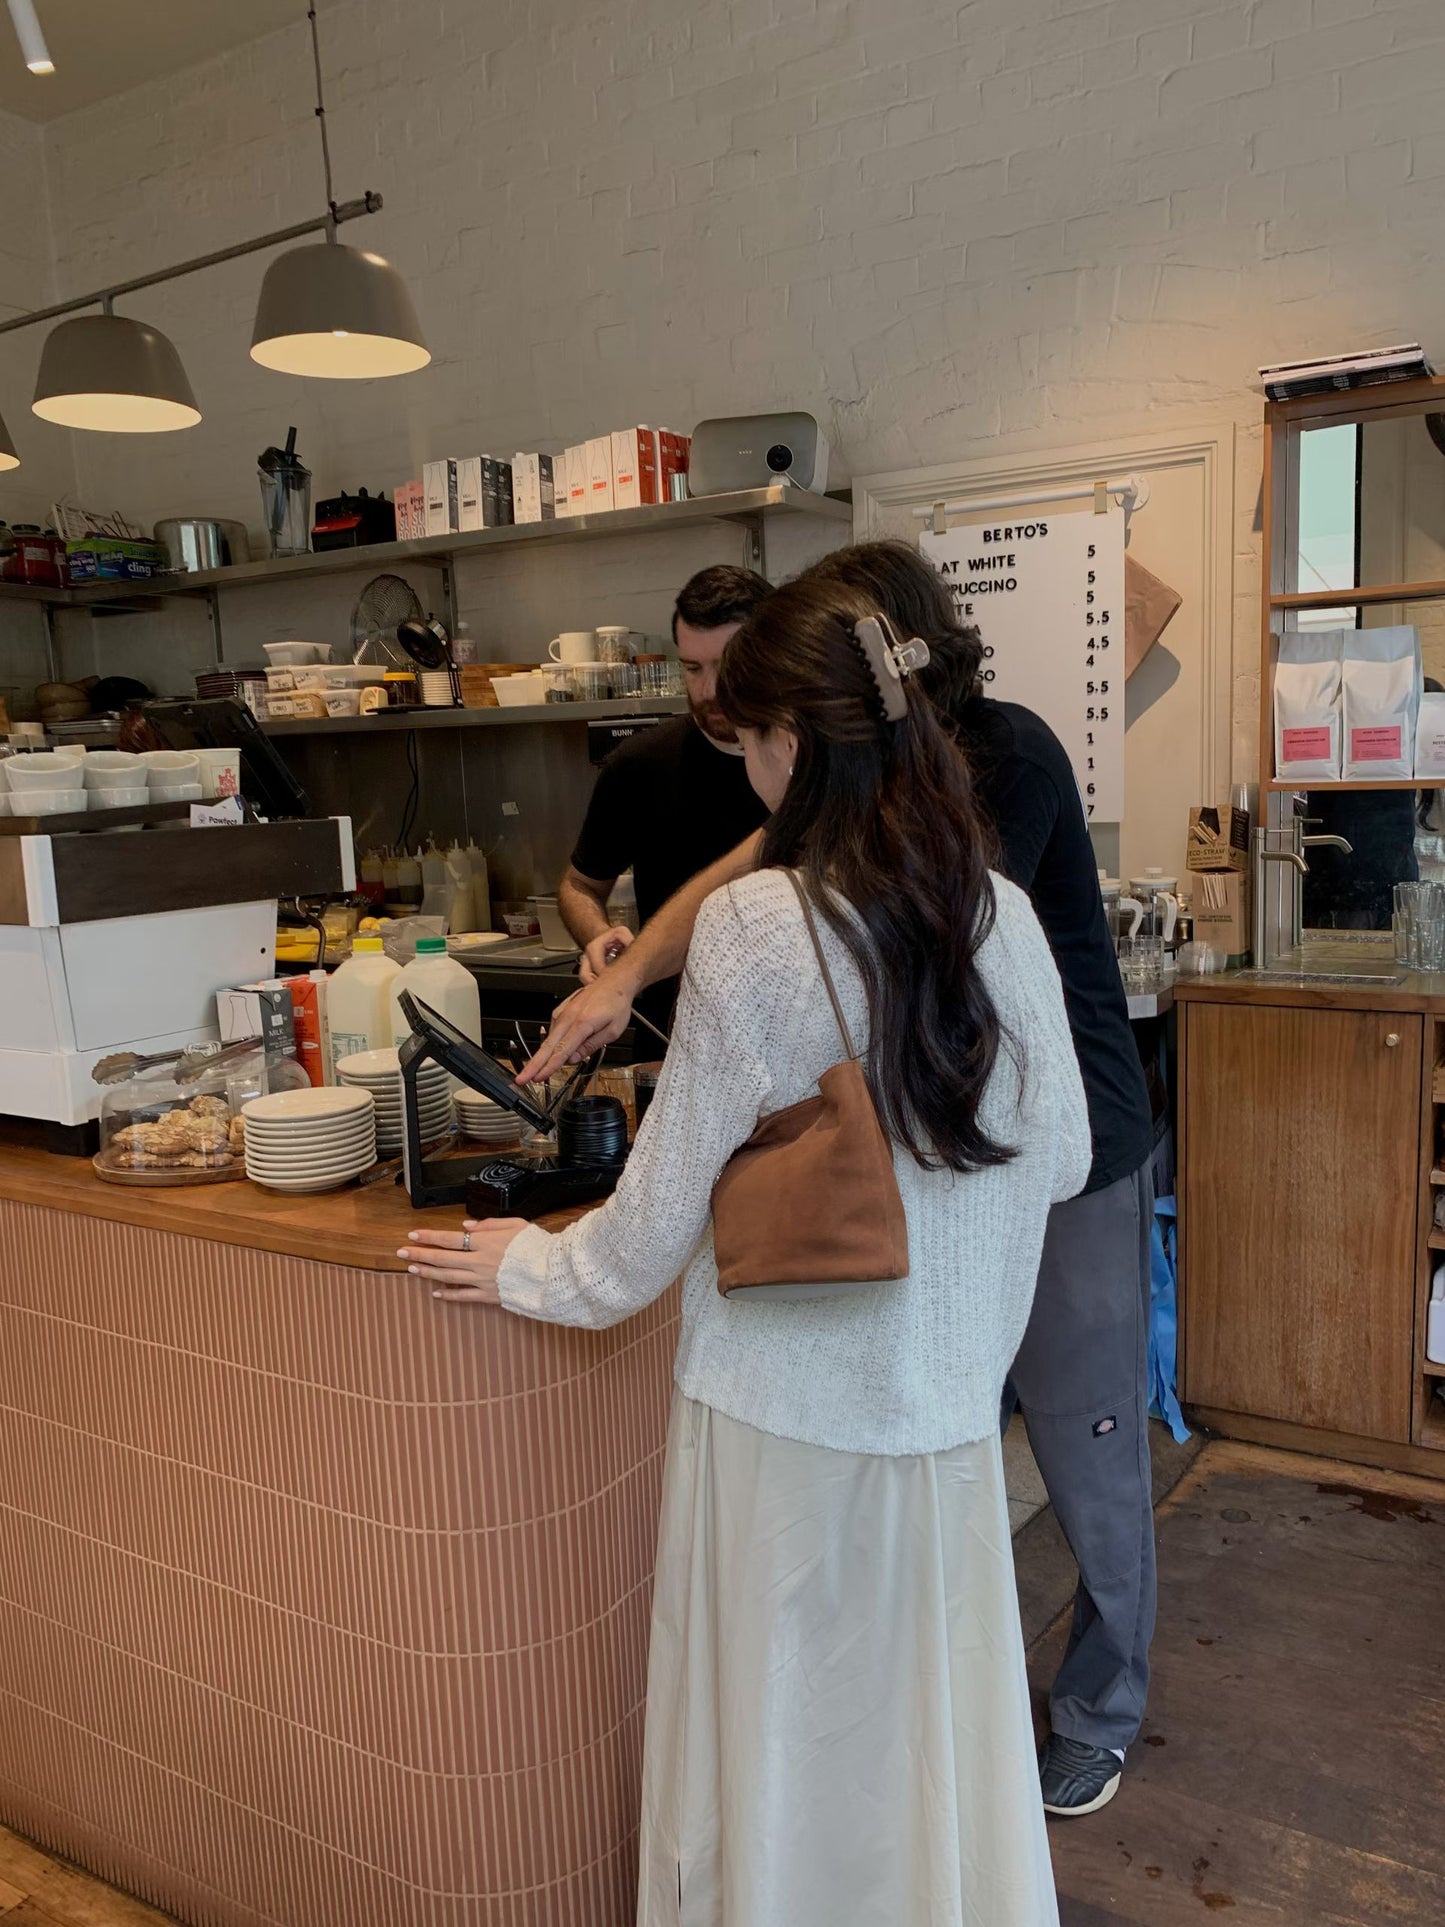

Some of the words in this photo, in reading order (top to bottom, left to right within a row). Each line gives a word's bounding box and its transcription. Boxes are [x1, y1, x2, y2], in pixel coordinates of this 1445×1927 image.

[983, 523, 1049, 543] BERTO'S
[1087, 545, 1096, 558] 5
[127, 561, 152, 577] cling
[931, 561, 960, 575] LAT
[968, 554, 1016, 571] WHITE
[1087, 571, 1096, 583] 5
[950, 578, 1017, 595] PUCCINO
[1086, 591, 1094, 604] 5
[1086, 610, 1109, 625] 5.5
[1087, 636, 1109, 650] 4.5
[1086, 654, 1095, 667] 4
[1086, 681, 1109, 694] 5.5
[1086, 707, 1109, 720] 5.5
[611, 728, 634, 737] BUNN
[1087, 732, 1094, 744] 1
[1087, 757, 1095, 769] 1
[1086, 783, 1095, 795] 6
[1087, 804, 1095, 817] 7
